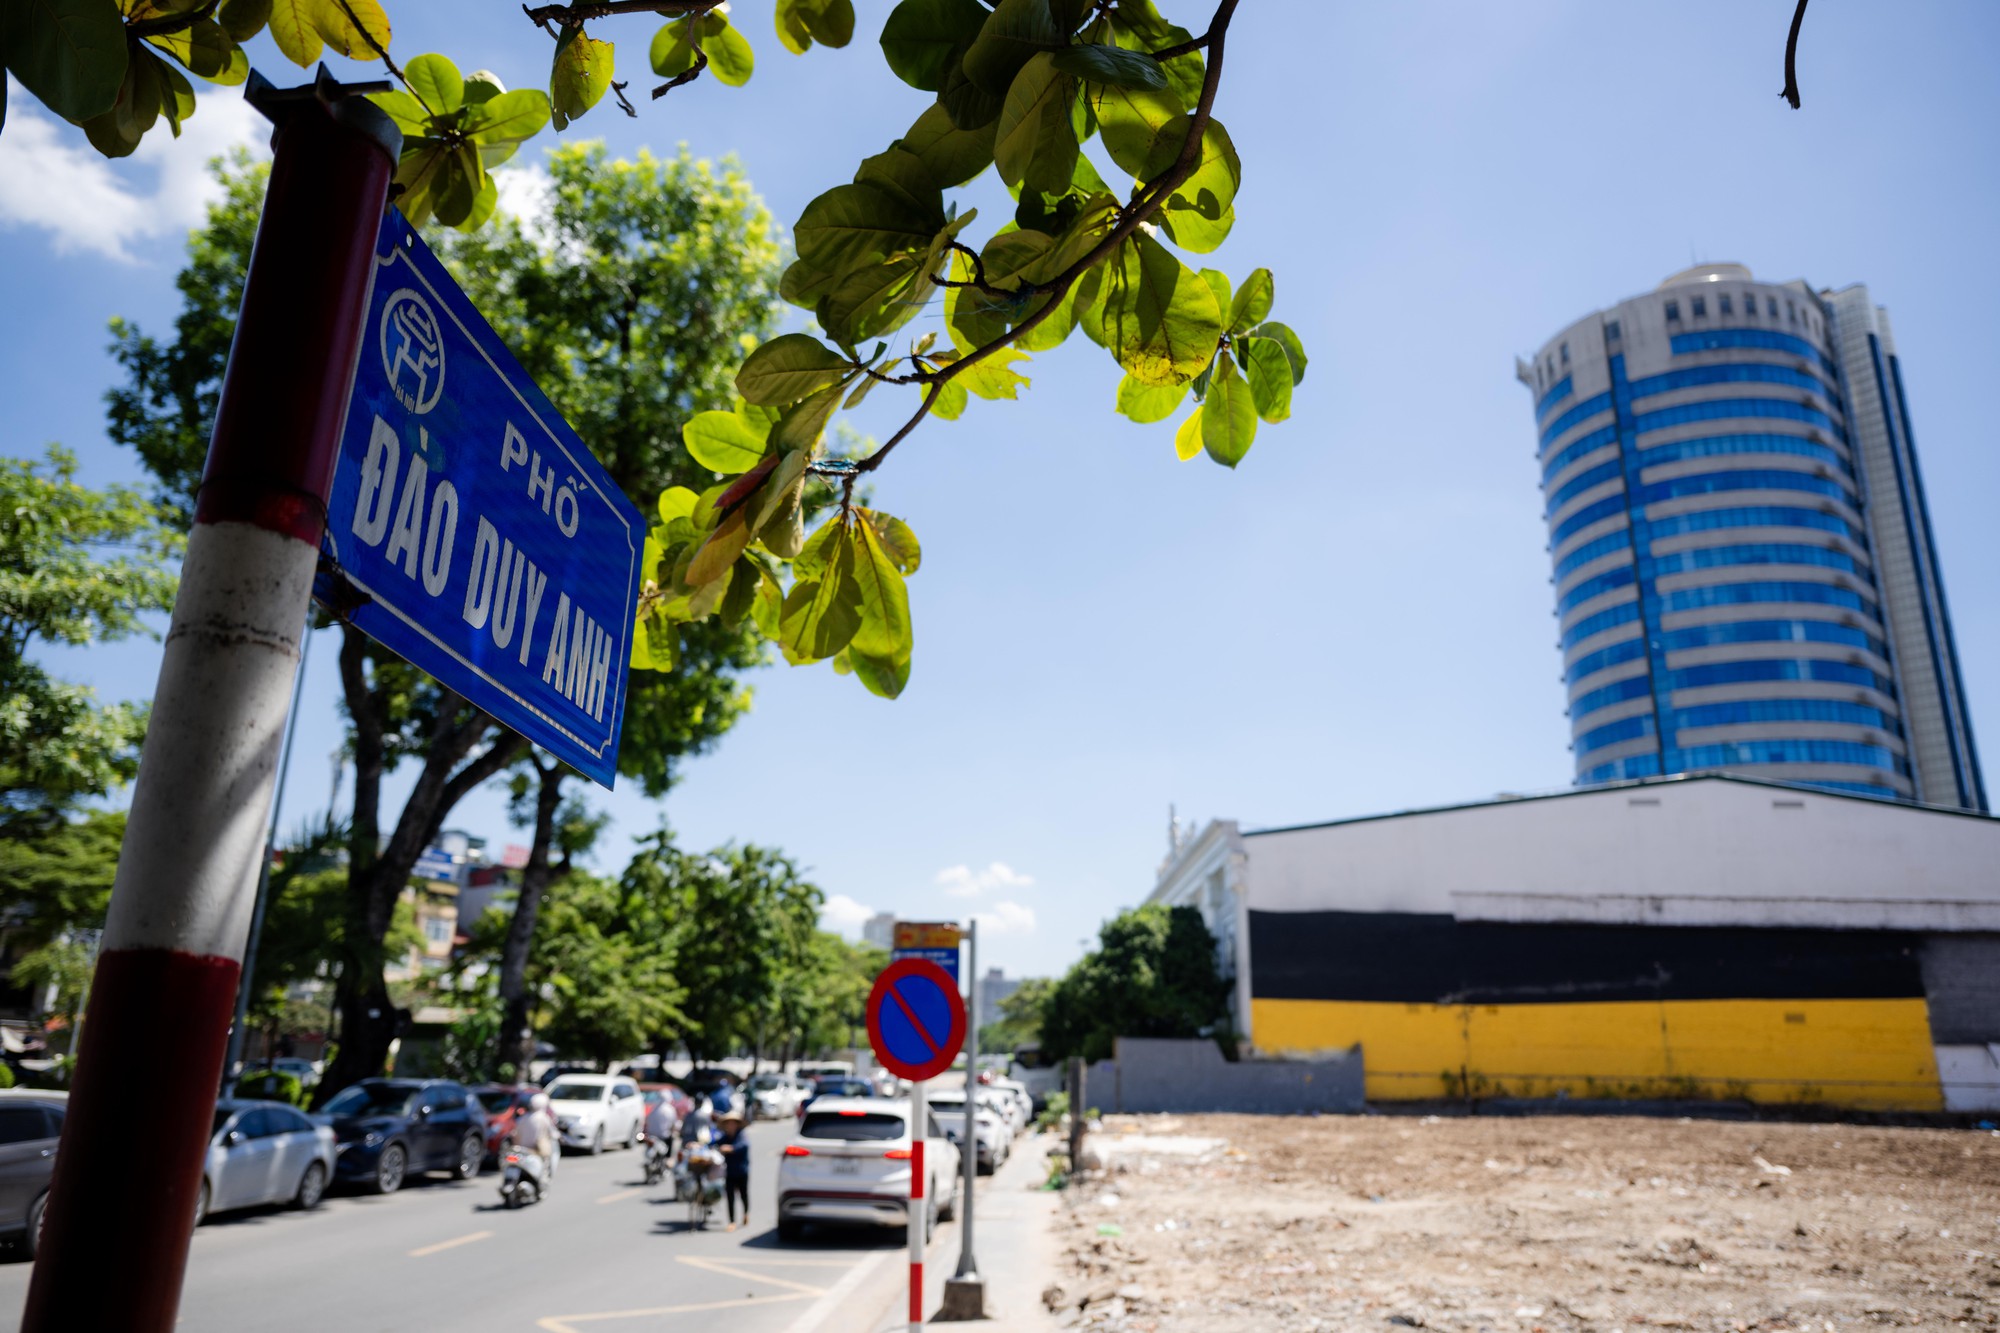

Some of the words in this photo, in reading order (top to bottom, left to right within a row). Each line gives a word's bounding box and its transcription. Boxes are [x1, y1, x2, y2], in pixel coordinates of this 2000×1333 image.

[352, 413, 459, 597] ĐÀO
[462, 514, 548, 667] DUY
[542, 591, 613, 723] ANH
[500, 419, 588, 539] PHỐ
